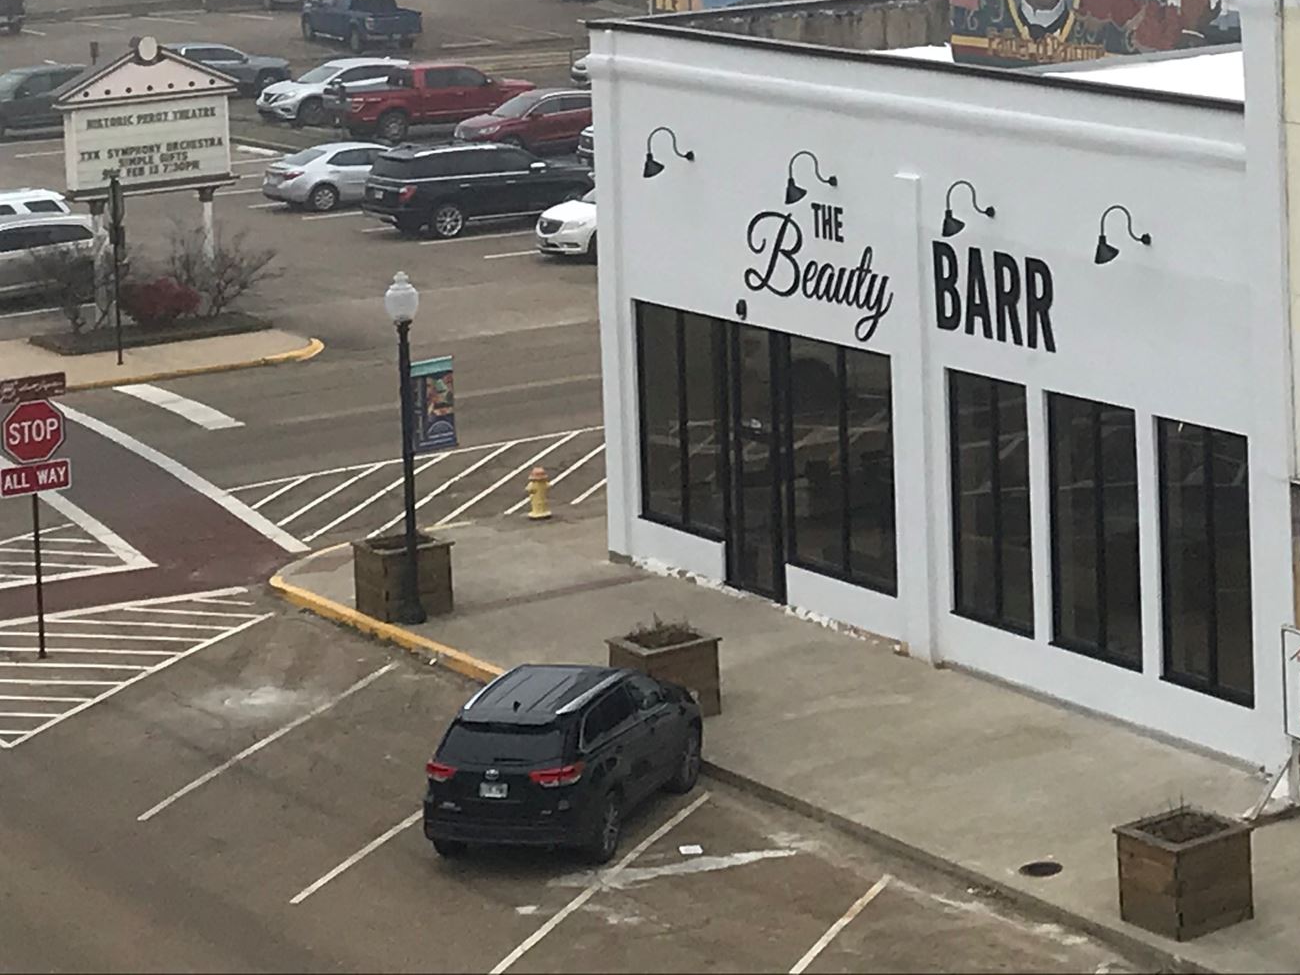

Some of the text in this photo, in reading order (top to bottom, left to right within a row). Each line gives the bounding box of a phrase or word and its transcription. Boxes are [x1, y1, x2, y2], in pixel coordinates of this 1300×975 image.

[86, 106, 216, 130] HISTORIC PEROT THEATRE
[107, 143, 161, 159] SYMPHONY
[166, 137, 223, 152] ORCHESTRA
[118, 151, 188, 168] SIMPLE GIFTS
[126, 165, 145, 177] FEB
[811, 202, 844, 242] THE
[744, 211, 893, 342] Beauty
[932, 240, 1056, 353] BARR
[9, 418, 58, 445] STOP
[4, 466, 66, 491] ALL WAY
